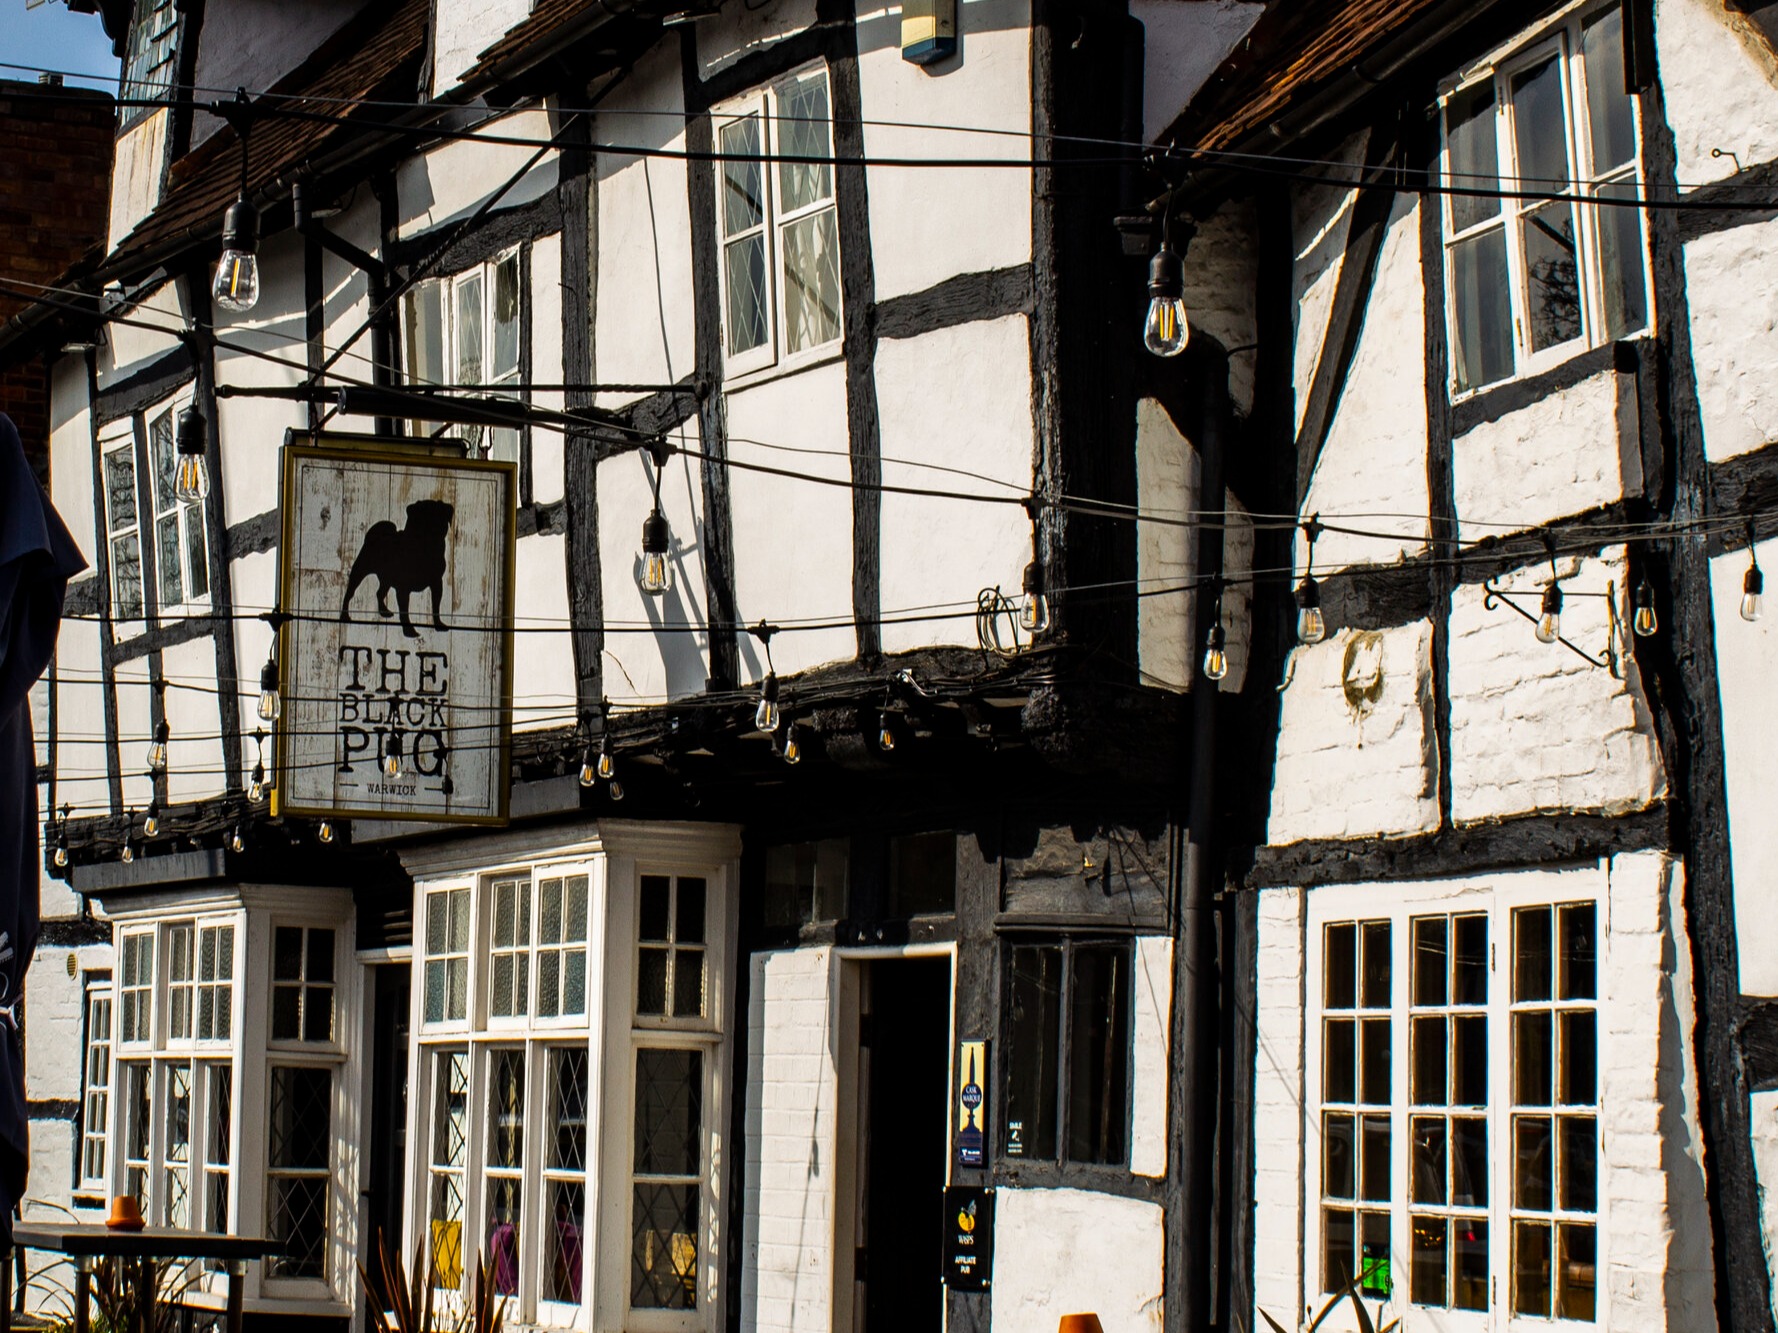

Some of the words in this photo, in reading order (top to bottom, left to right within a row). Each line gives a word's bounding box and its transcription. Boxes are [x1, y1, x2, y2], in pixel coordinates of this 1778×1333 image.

[340, 645, 448, 696] THE
[339, 693, 448, 727] BLACK
[367, 783, 417, 796] WARWICK
[955, 1255, 976, 1265] AFFILIATE
[960, 1265, 971, 1274] PUB
